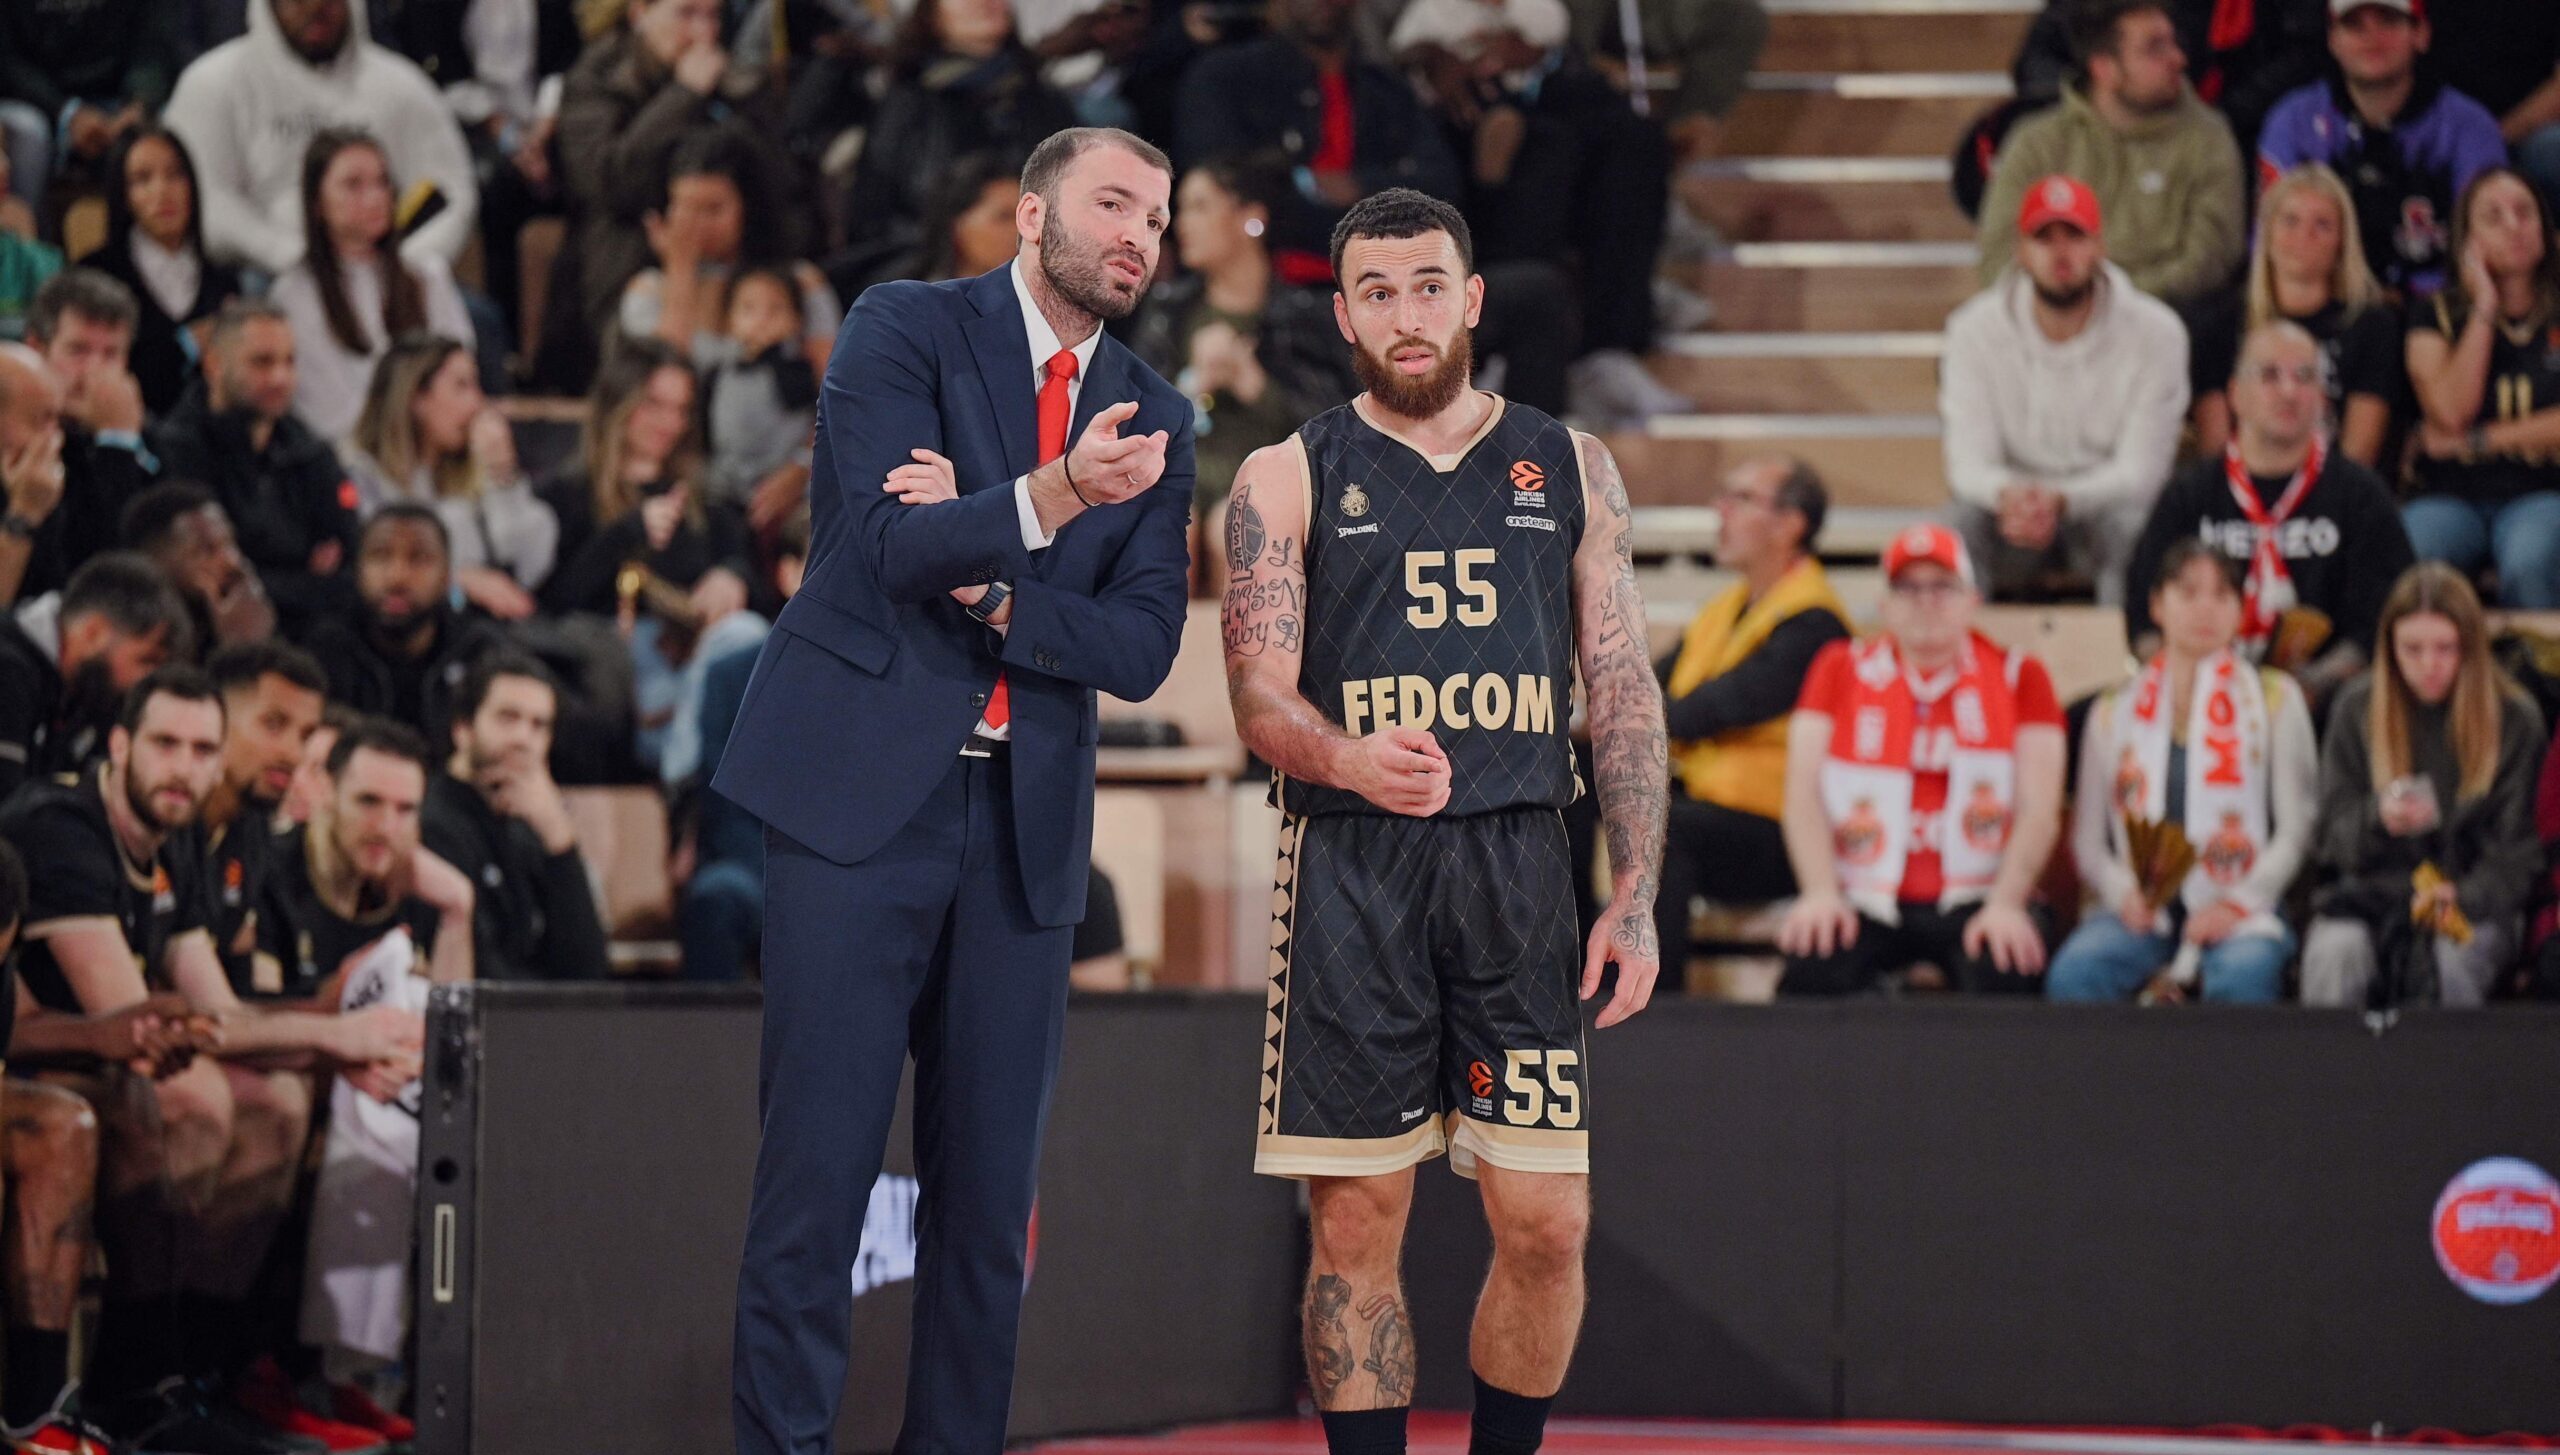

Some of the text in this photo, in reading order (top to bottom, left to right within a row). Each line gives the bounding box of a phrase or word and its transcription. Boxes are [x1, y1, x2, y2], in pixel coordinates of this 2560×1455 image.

[1513, 490, 1545, 498] TURKISH
[1514, 496, 1546, 504] AIRLINES
[1337, 523, 1379, 538] SPALDING
[1506, 515, 1556, 532] oneteam
[1405, 548, 1497, 629] 55
[1342, 672, 1555, 737] FEDCOM
[1504, 1049, 1580, 1128] 55
